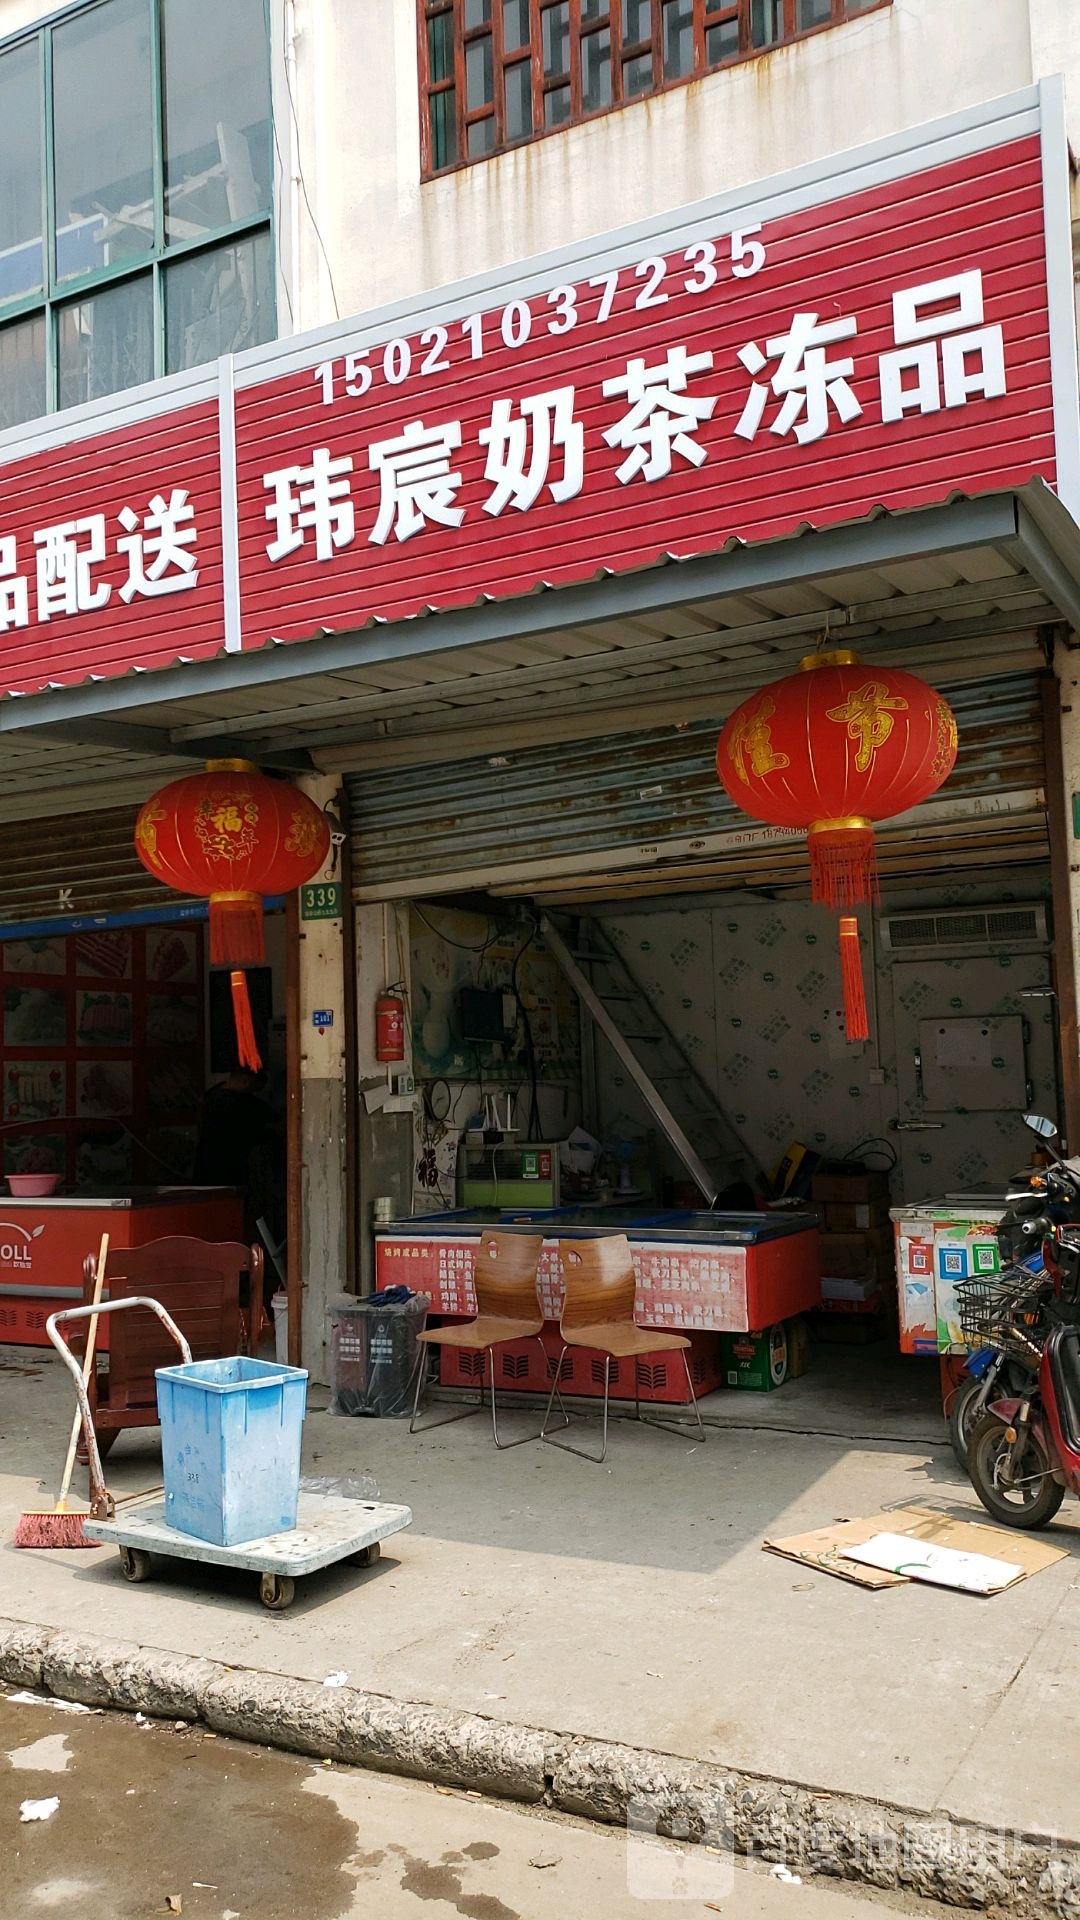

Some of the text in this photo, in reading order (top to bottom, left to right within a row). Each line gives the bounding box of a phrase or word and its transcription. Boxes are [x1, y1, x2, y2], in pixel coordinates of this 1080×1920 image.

[314, 222, 767, 407] 15021037235
[263, 270, 1007, 562] 玮宸奶茶冻品
[306, 888, 336, 907] 339
